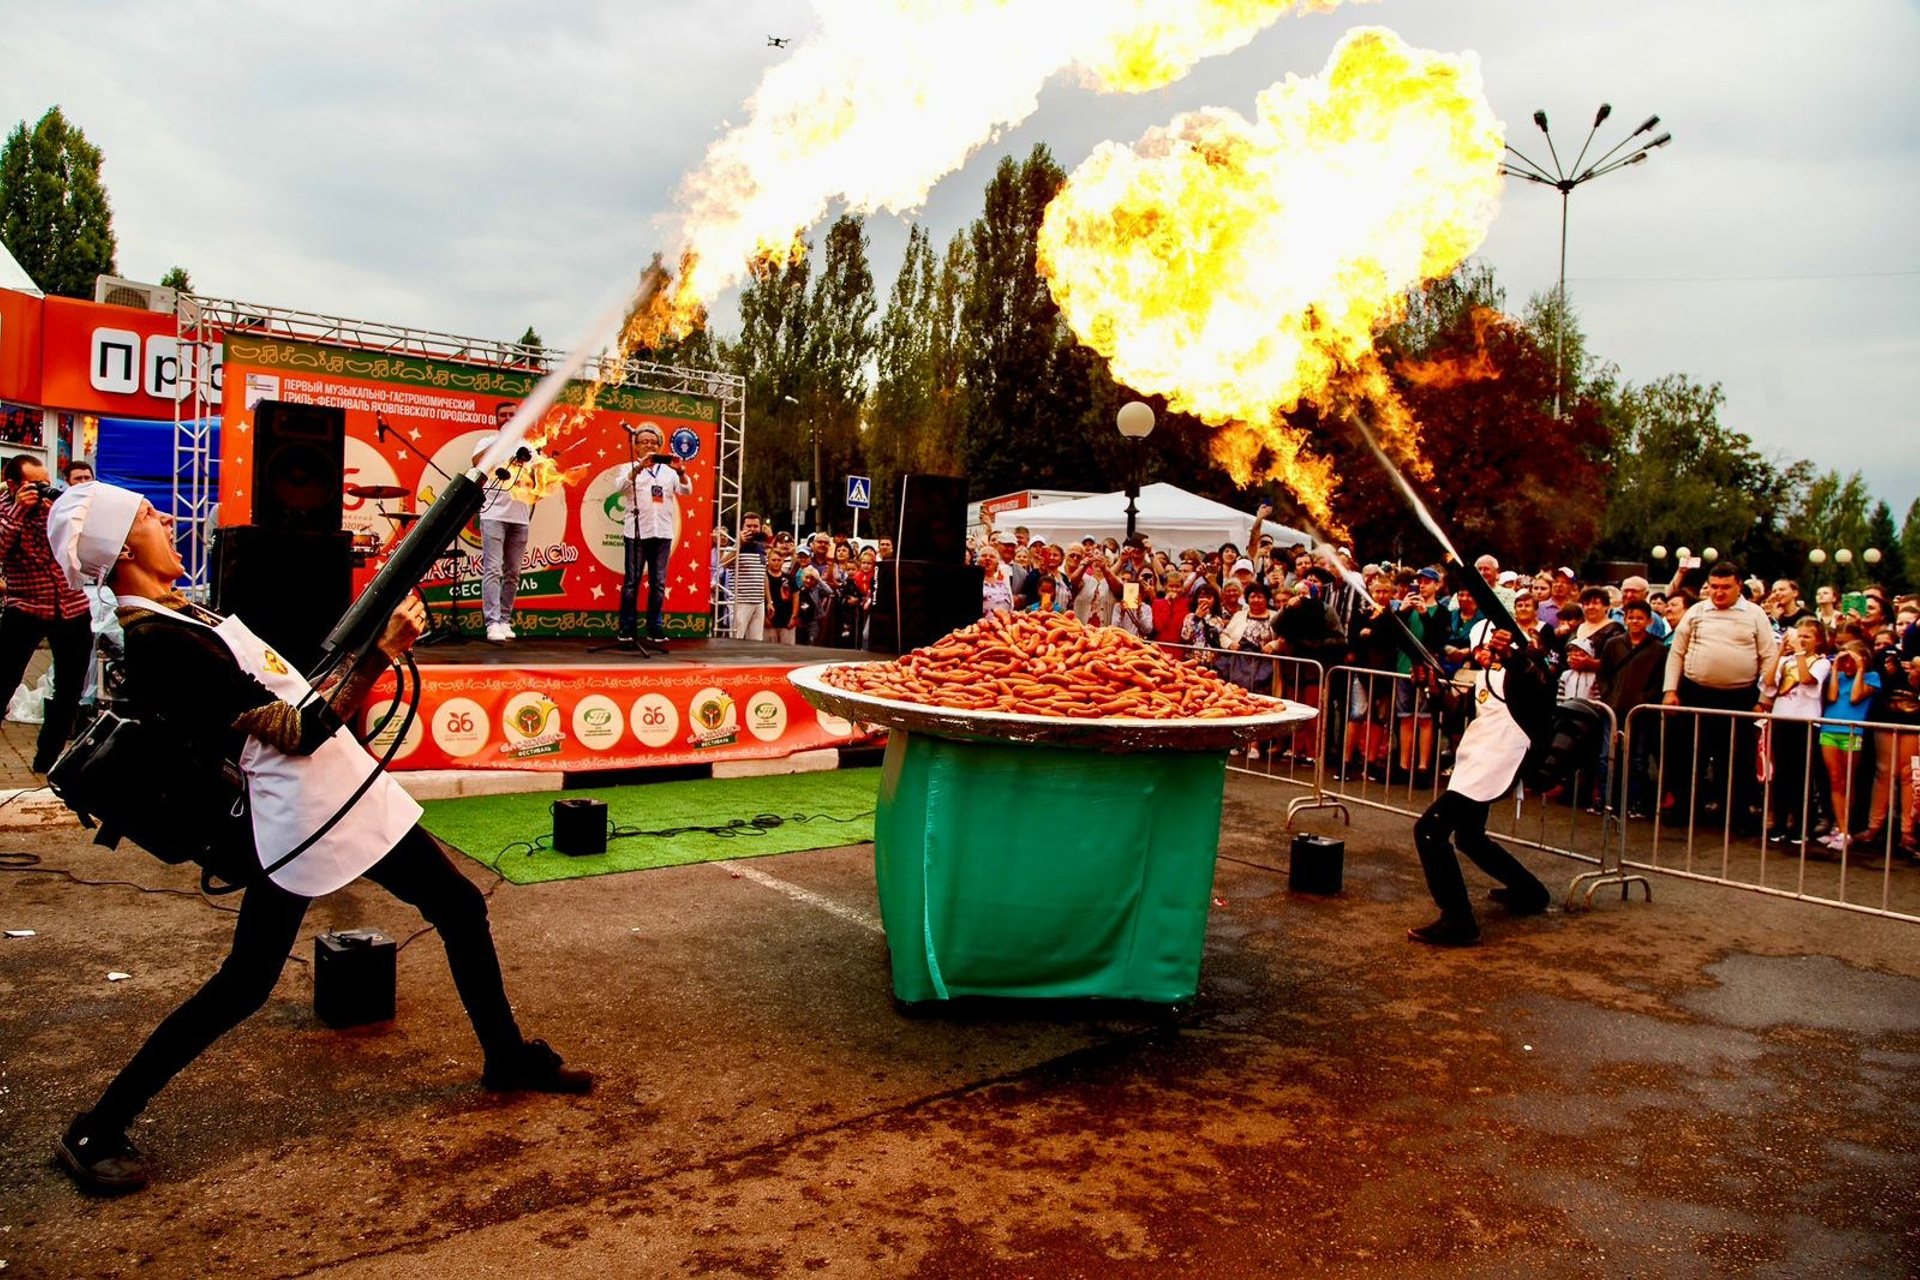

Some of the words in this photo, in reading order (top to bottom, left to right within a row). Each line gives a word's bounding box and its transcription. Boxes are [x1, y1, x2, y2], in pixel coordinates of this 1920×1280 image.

[284, 378, 323, 393] ПЕРВЫЙ
[324, 383, 476, 411] МУЗЫКАЛЬНО-ГАСТРОНОМИЧЕСКИЙ
[436, 408, 488, 424] ГОРОДСКОГО
[518, 746, 552, 757] ФЕСТИВАЛЬ
